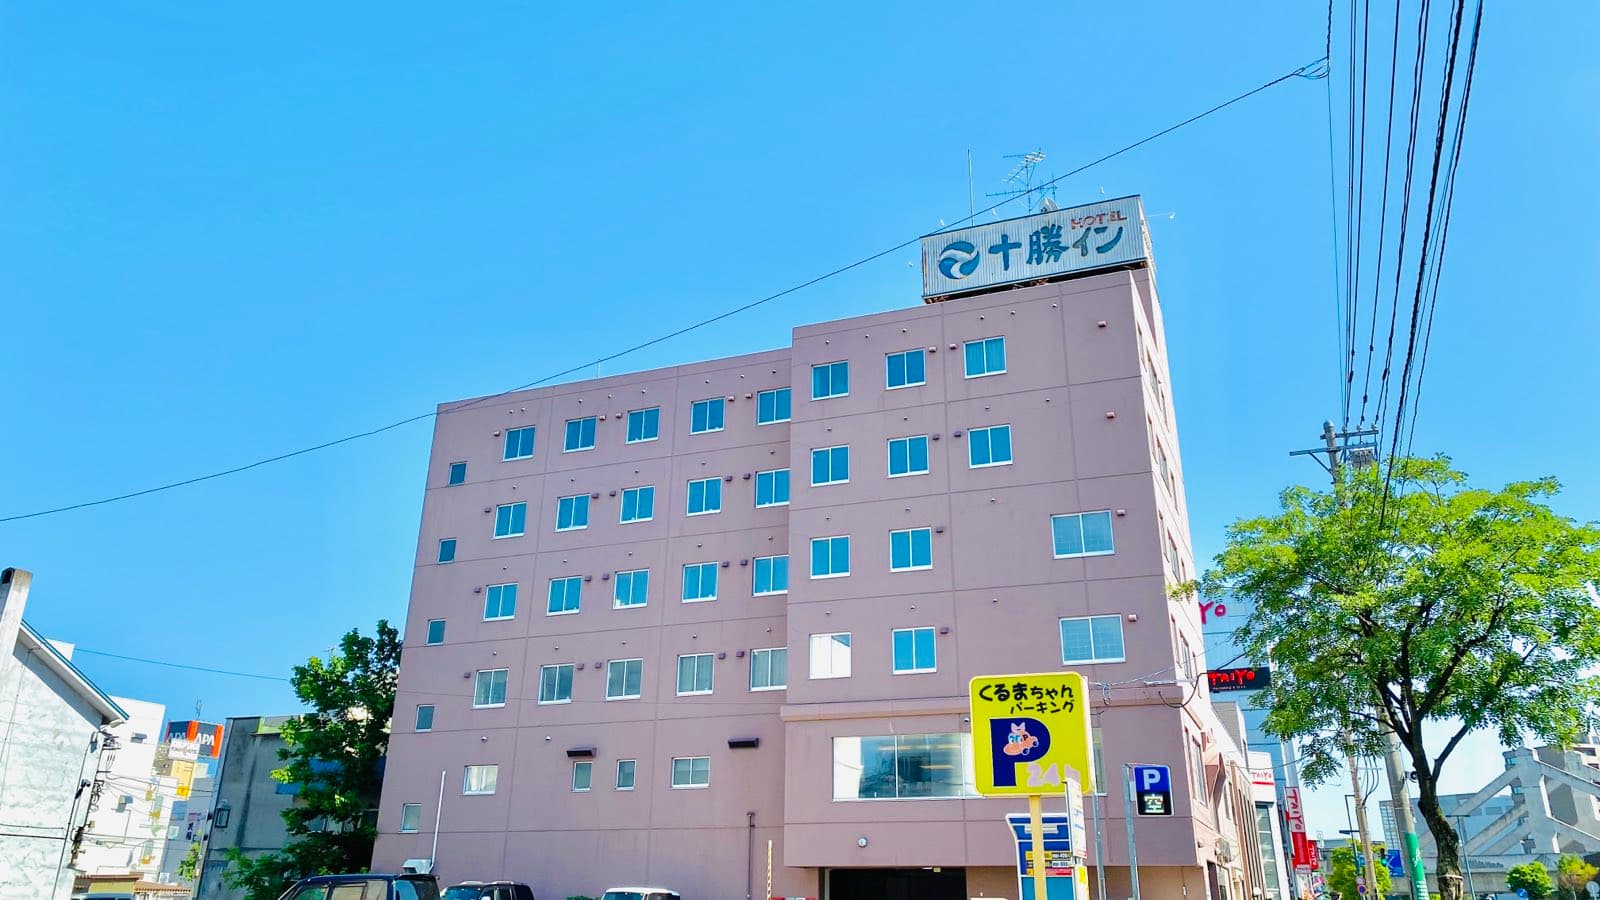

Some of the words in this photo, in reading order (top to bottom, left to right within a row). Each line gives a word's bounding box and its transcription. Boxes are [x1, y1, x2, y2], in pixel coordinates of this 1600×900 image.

[1071, 210, 1127, 230] HOTEL
[988, 223, 1123, 271] 十勝イン
[979, 682, 1074, 702] くるまちゃん
[1010, 699, 1075, 714] パーキング
[194, 733, 215, 746] APA
[990, 717, 1051, 786] P
[1143, 769, 1161, 790] P
[1144, 793, 1165, 813] 空
[1287, 789, 1303, 830] TAIYO
